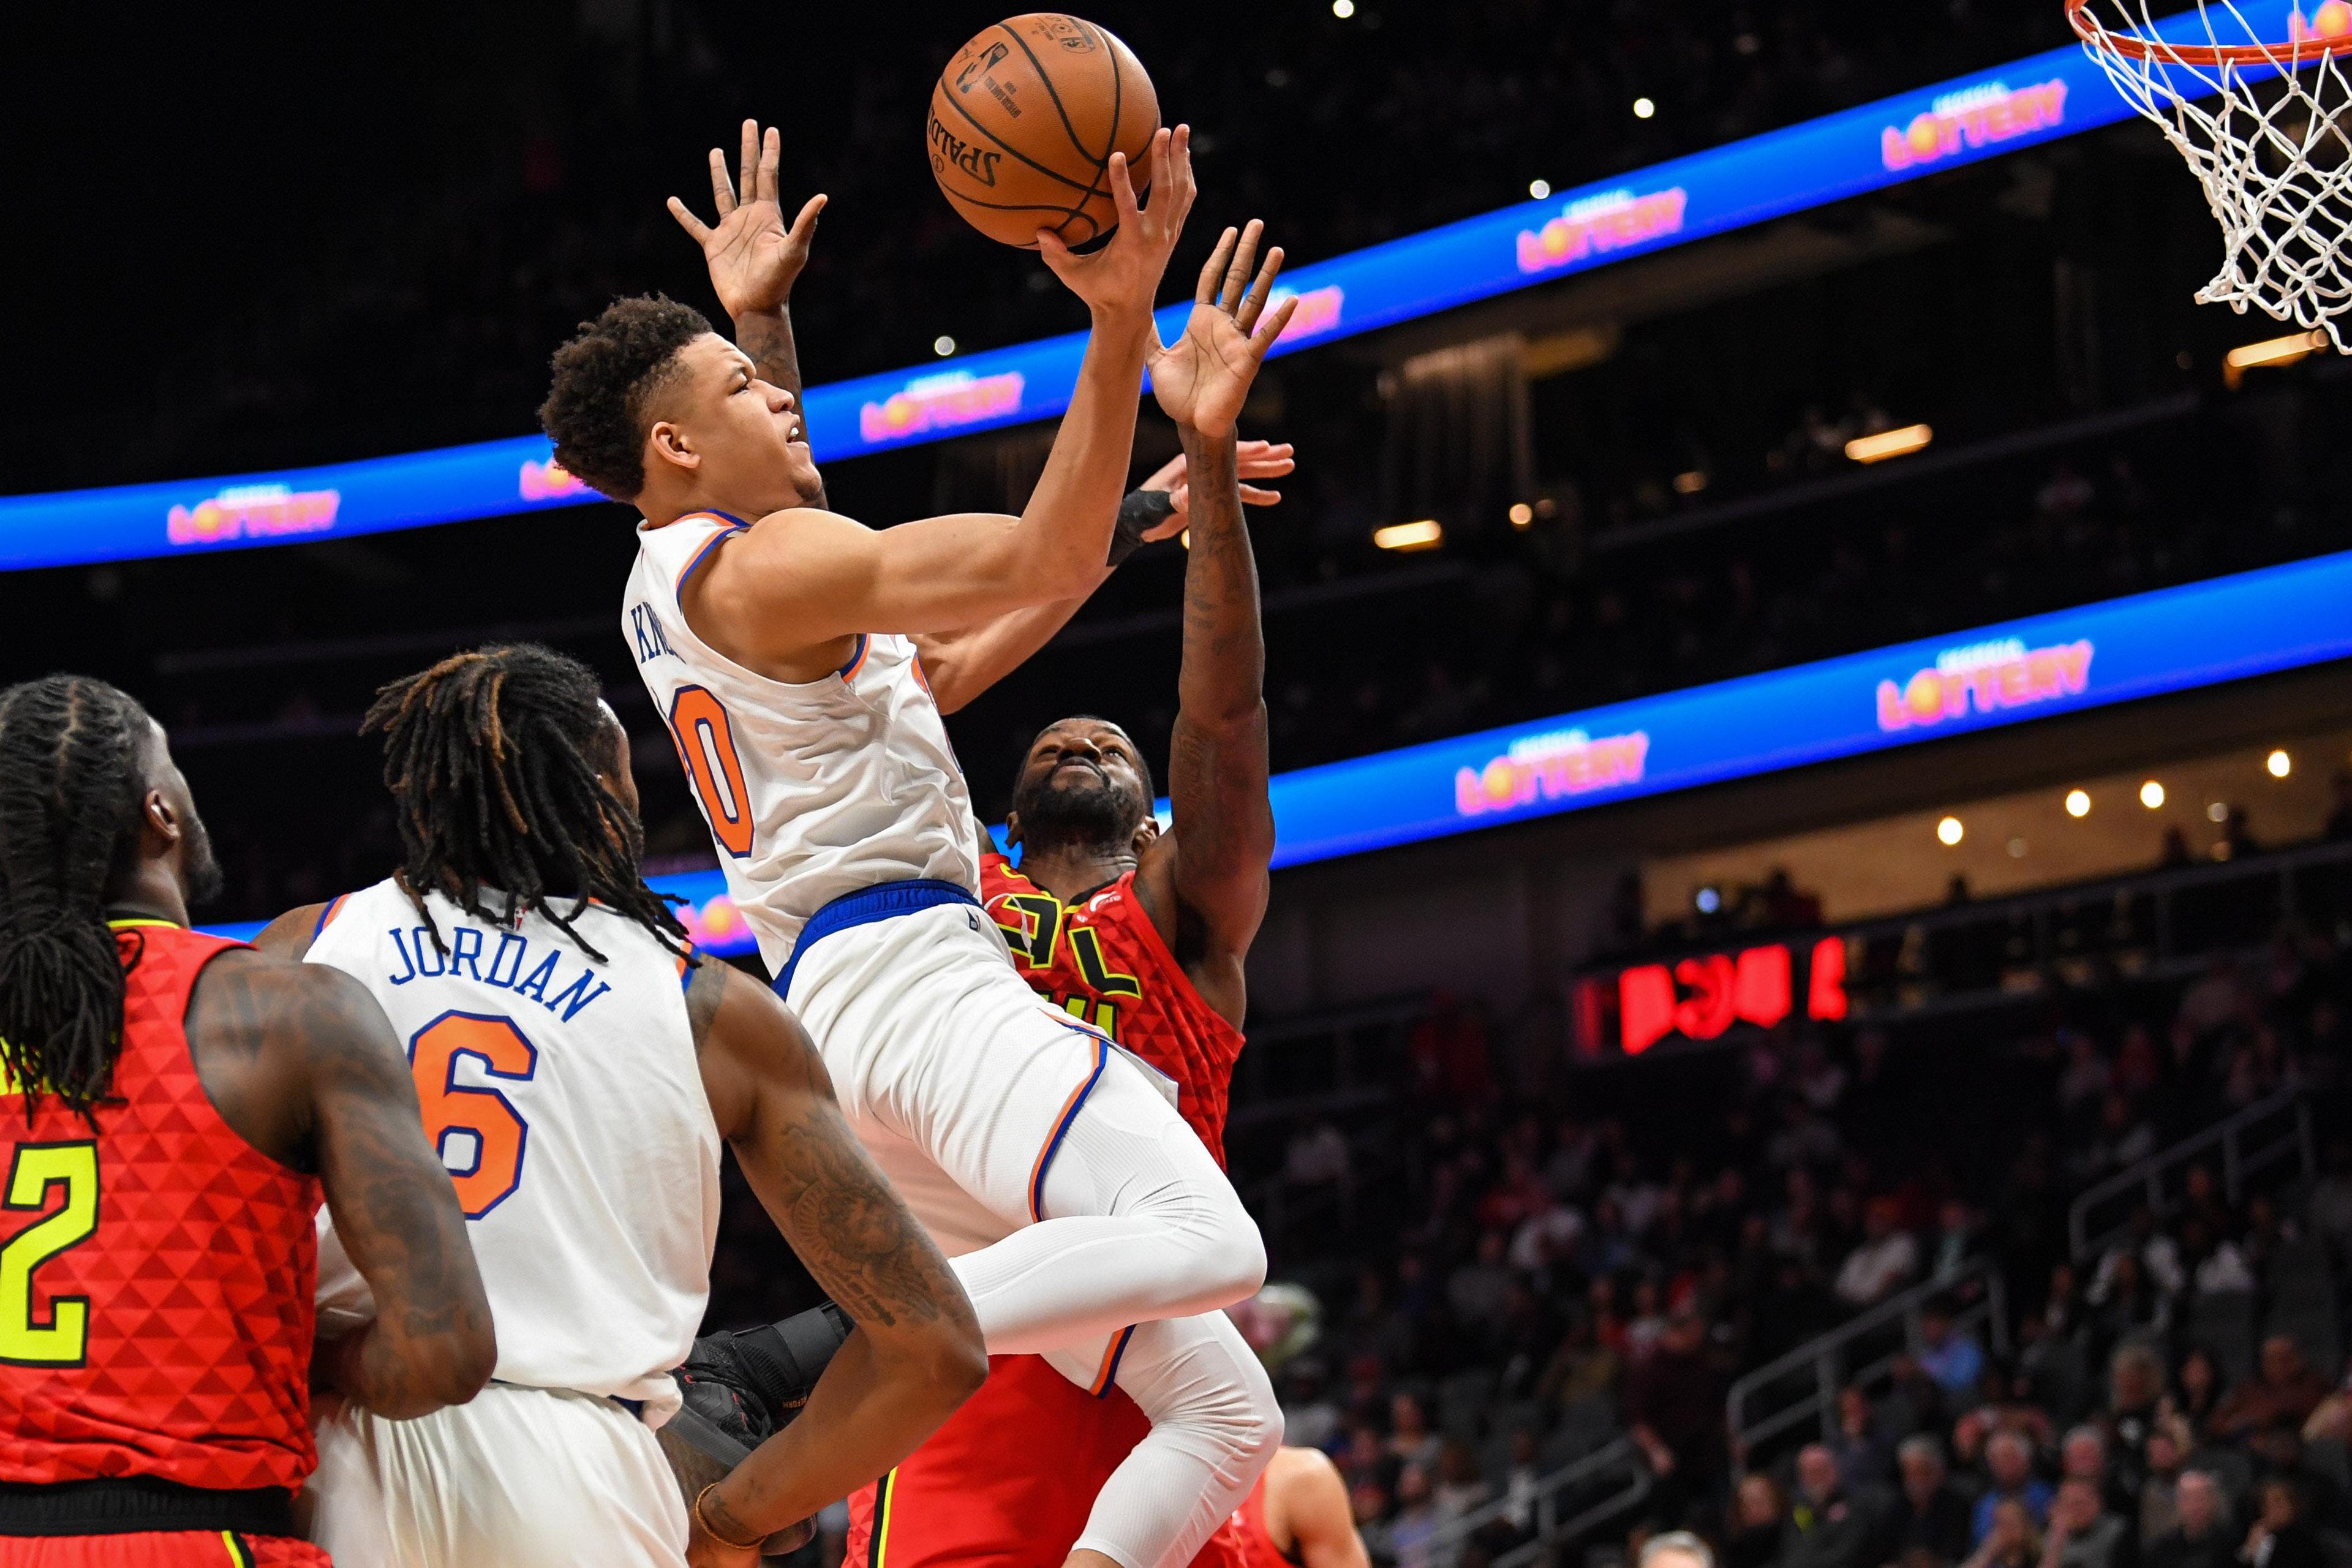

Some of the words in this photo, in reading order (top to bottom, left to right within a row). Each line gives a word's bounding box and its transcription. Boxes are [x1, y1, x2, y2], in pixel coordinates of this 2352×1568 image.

[652, 684, 754, 858] 0
[388, 925, 611, 1023] JORDAN
[407, 1009, 538, 1221] 6
[0, 1139, 100, 1369] 2
